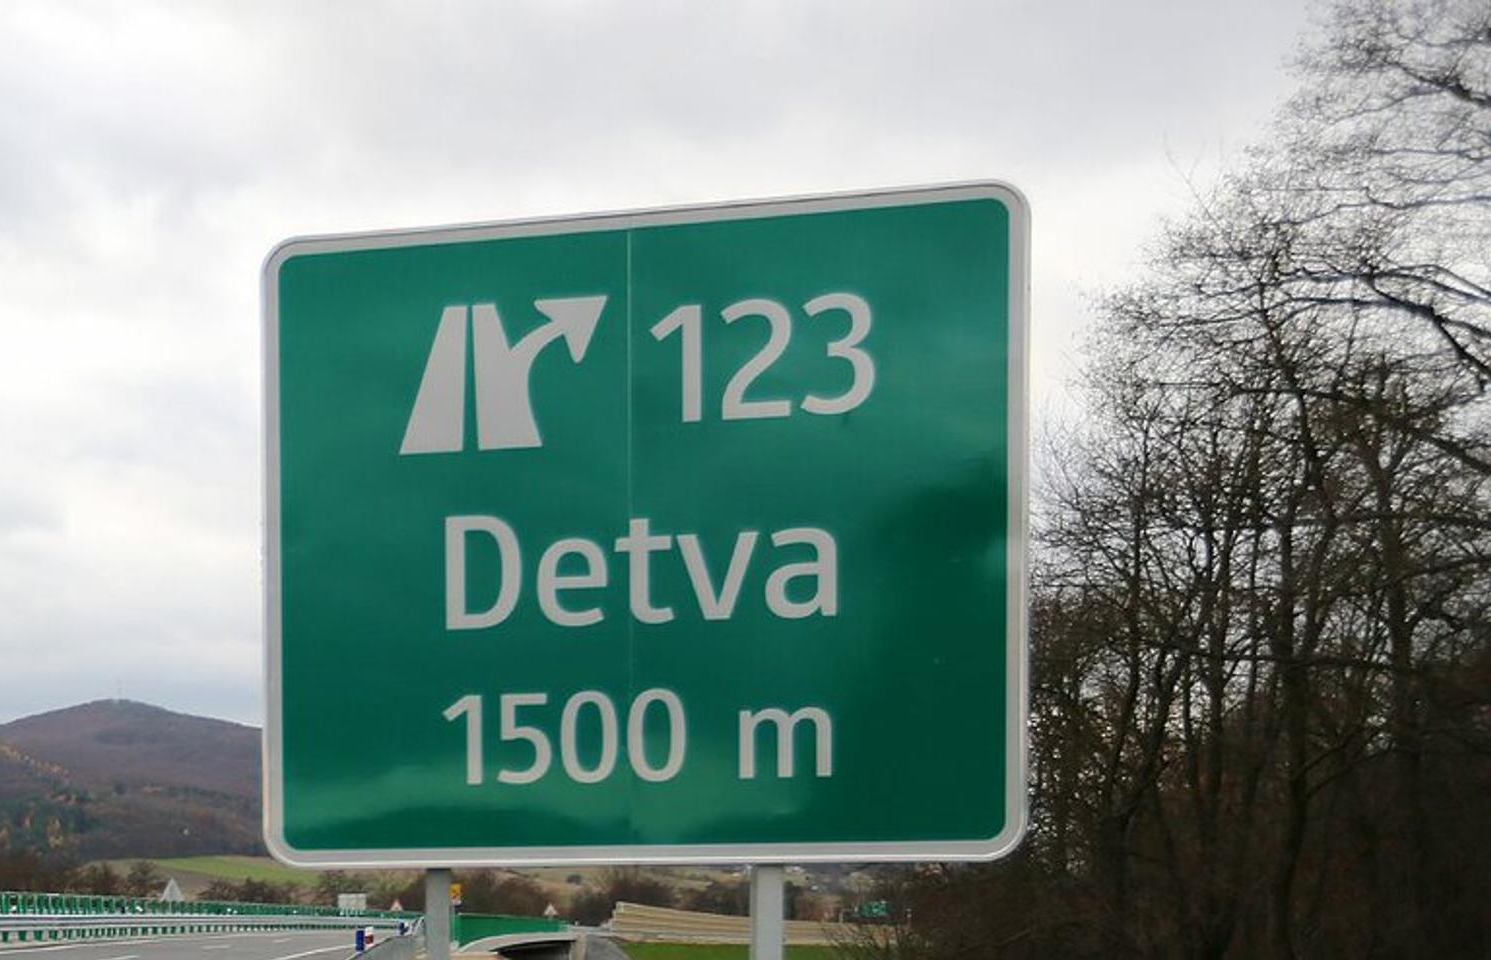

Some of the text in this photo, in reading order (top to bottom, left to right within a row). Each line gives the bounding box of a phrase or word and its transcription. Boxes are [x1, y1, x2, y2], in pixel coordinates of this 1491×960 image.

[650, 292, 875, 422] 123
[445, 514, 839, 630] Detva
[442, 688, 834, 784] 1500 m
